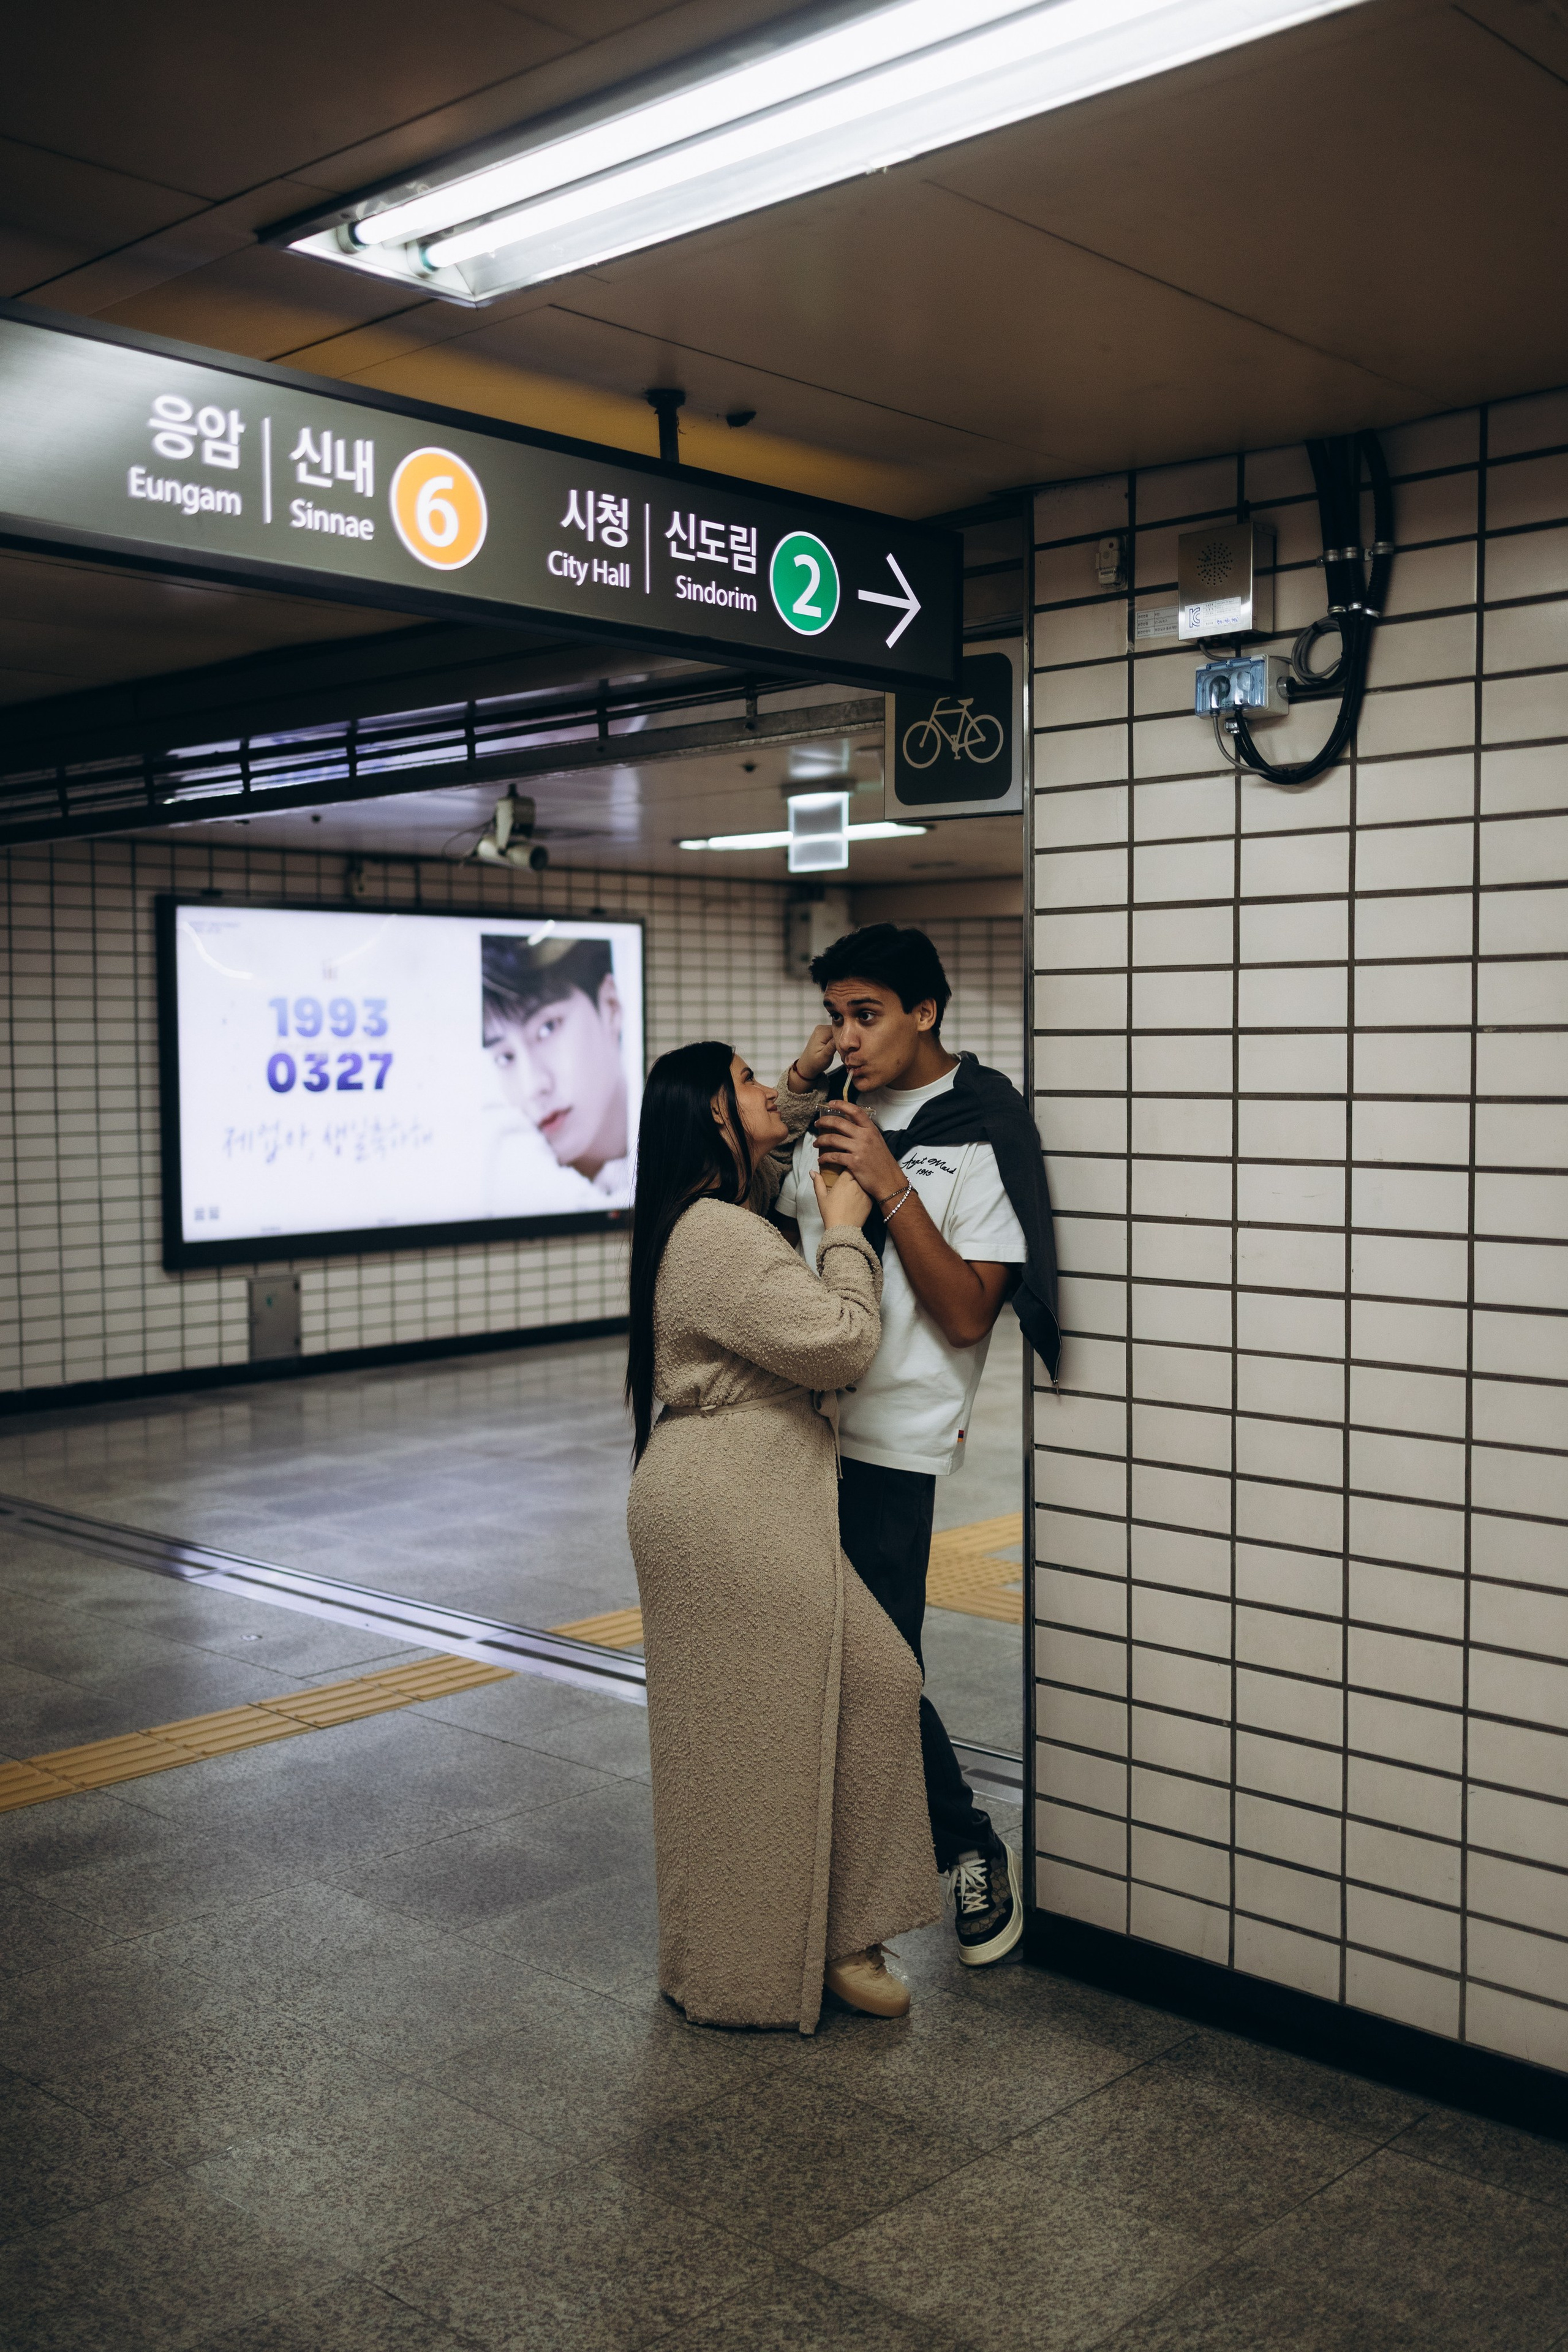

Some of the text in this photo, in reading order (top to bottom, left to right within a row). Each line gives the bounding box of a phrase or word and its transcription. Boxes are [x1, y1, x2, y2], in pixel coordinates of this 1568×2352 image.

[148, 394, 245, 469] 응암
[289, 427, 375, 498] 신내
[128, 465, 242, 516] Eungam
[417, 475, 459, 548] 6
[290, 498, 375, 541] Sinnae
[560, 489, 629, 548] 시청
[665, 510, 757, 575] 신도림
[547, 550, 630, 589] City Hall
[676, 574, 757, 612] Sindorim
[793, 554, 821, 618] 2
[268, 997, 390, 1039] 1993
[266, 1051, 394, 1095] 0327
[915, 1168, 935, 1177] 1915
